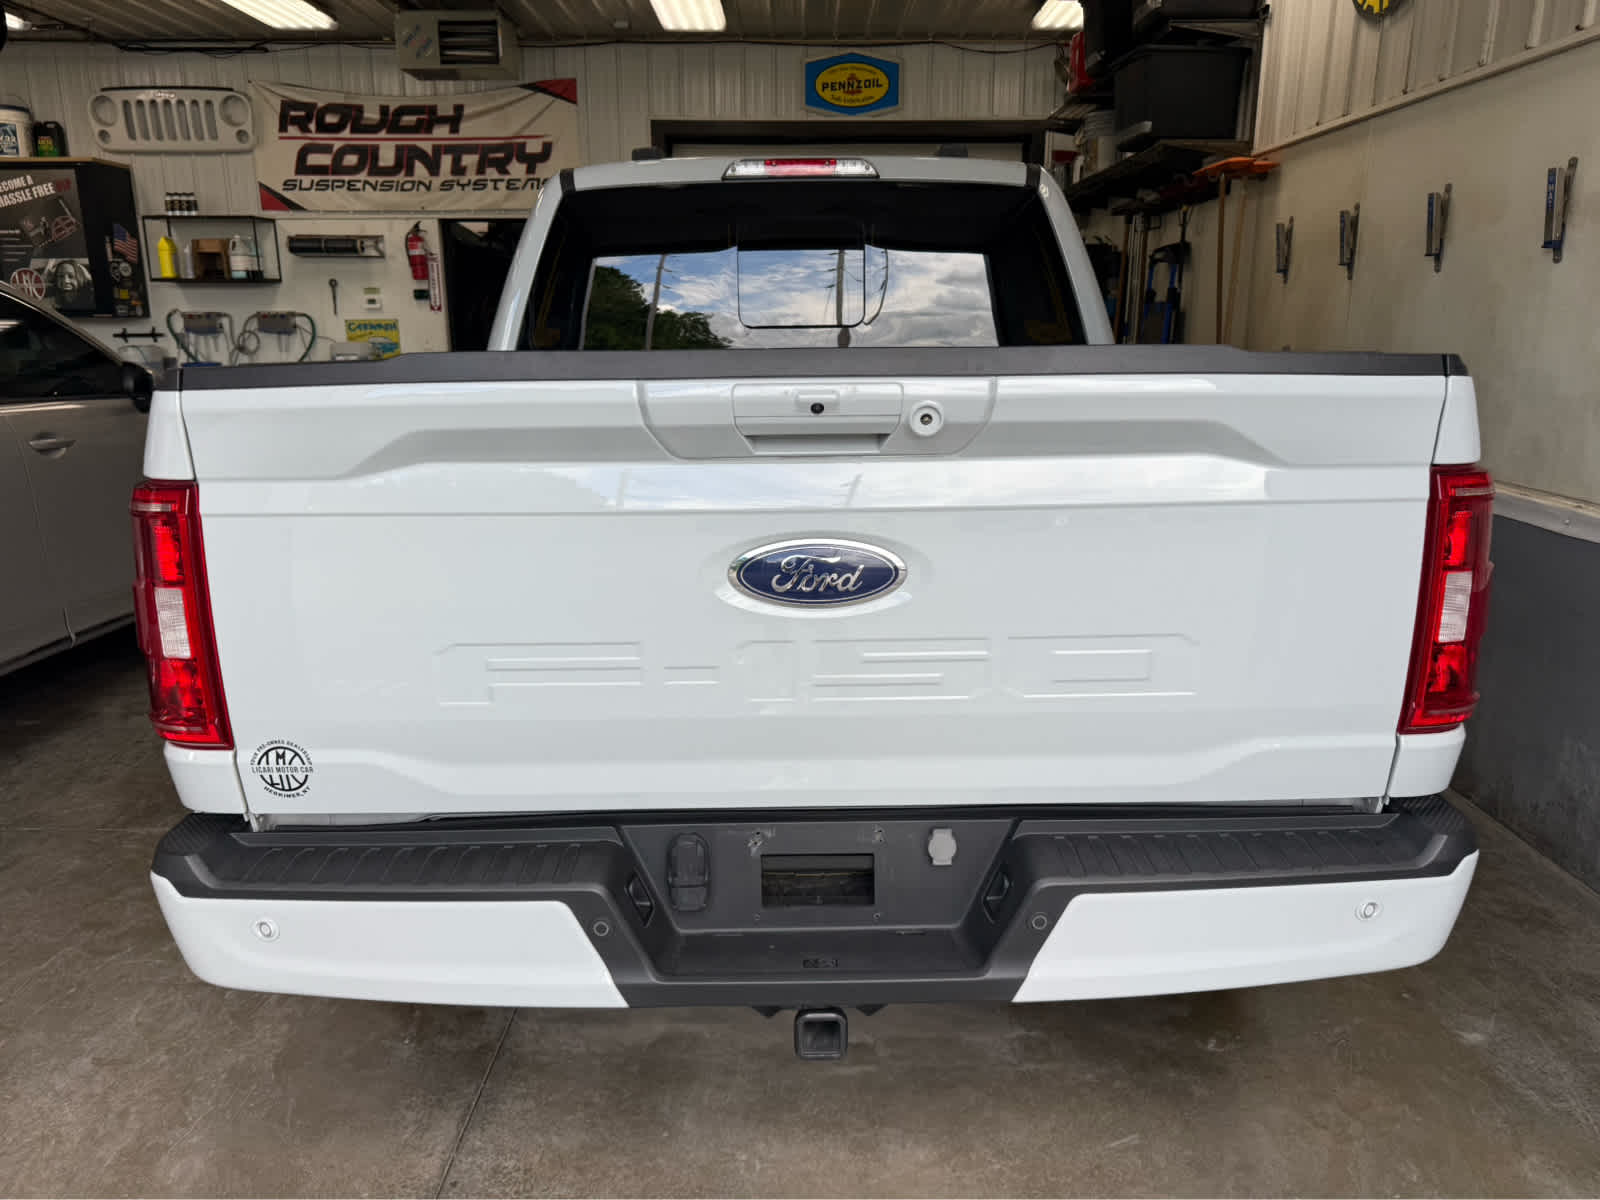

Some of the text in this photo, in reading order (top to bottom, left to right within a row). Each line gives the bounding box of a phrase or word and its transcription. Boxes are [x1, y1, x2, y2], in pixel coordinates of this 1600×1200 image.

[821, 78, 883, 92] PENNZOIL
[278, 99, 465, 135] ROUGH
[294, 141, 553, 177] COUNTRY
[32, 182, 56, 199] FREE
[282, 178, 432, 192] SUSPENSION
[771, 554, 865, 593] Ford
[275, 766, 299, 774] MOTOR
[300, 766, 314, 774] CAR
